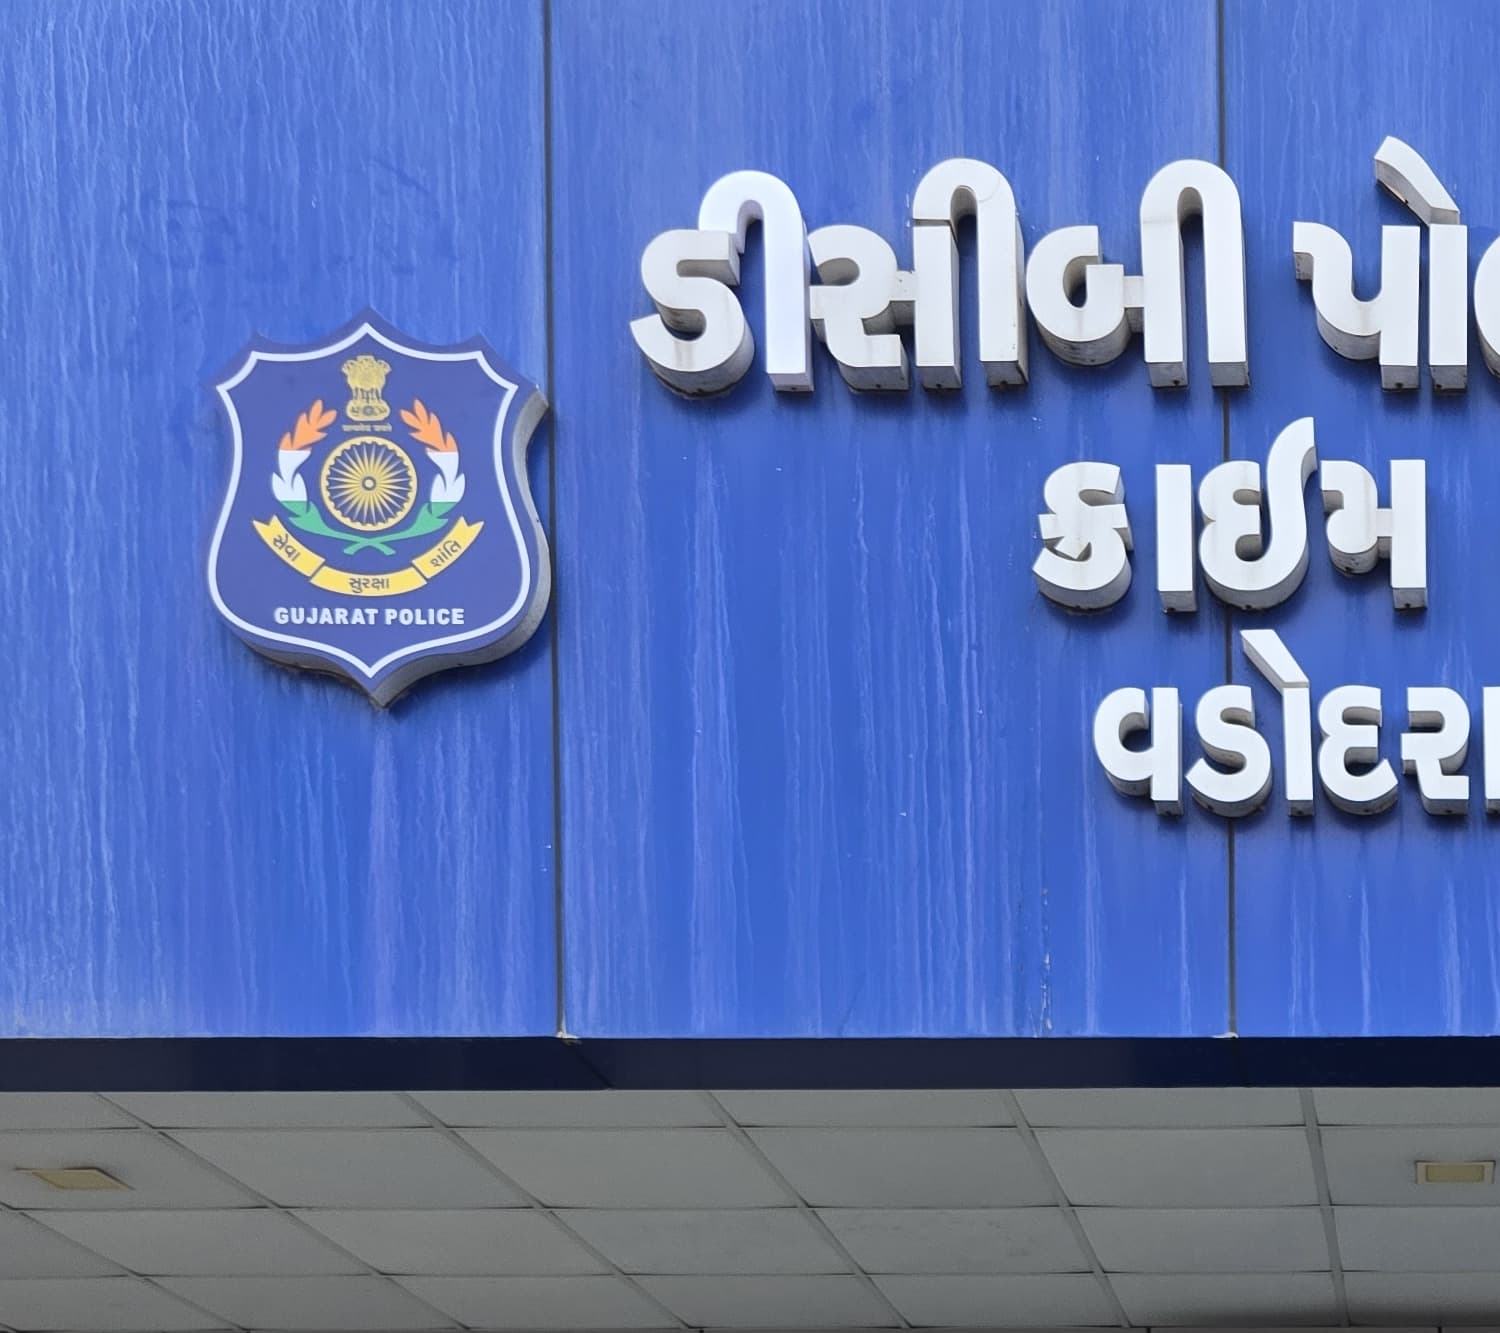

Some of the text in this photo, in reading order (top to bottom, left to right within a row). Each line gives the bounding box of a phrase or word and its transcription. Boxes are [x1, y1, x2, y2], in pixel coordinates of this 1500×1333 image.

[630, 158, 1248, 390] ડીસીબી
[1033, 416, 1427, 609] ક્રાઈમ
[271, 533, 301, 563] સેવા
[430, 539, 462, 568] શાંતિ
[348, 577, 390, 594] સુરક્ષા
[274, 607, 465, 625] GUJARAT POLICE
